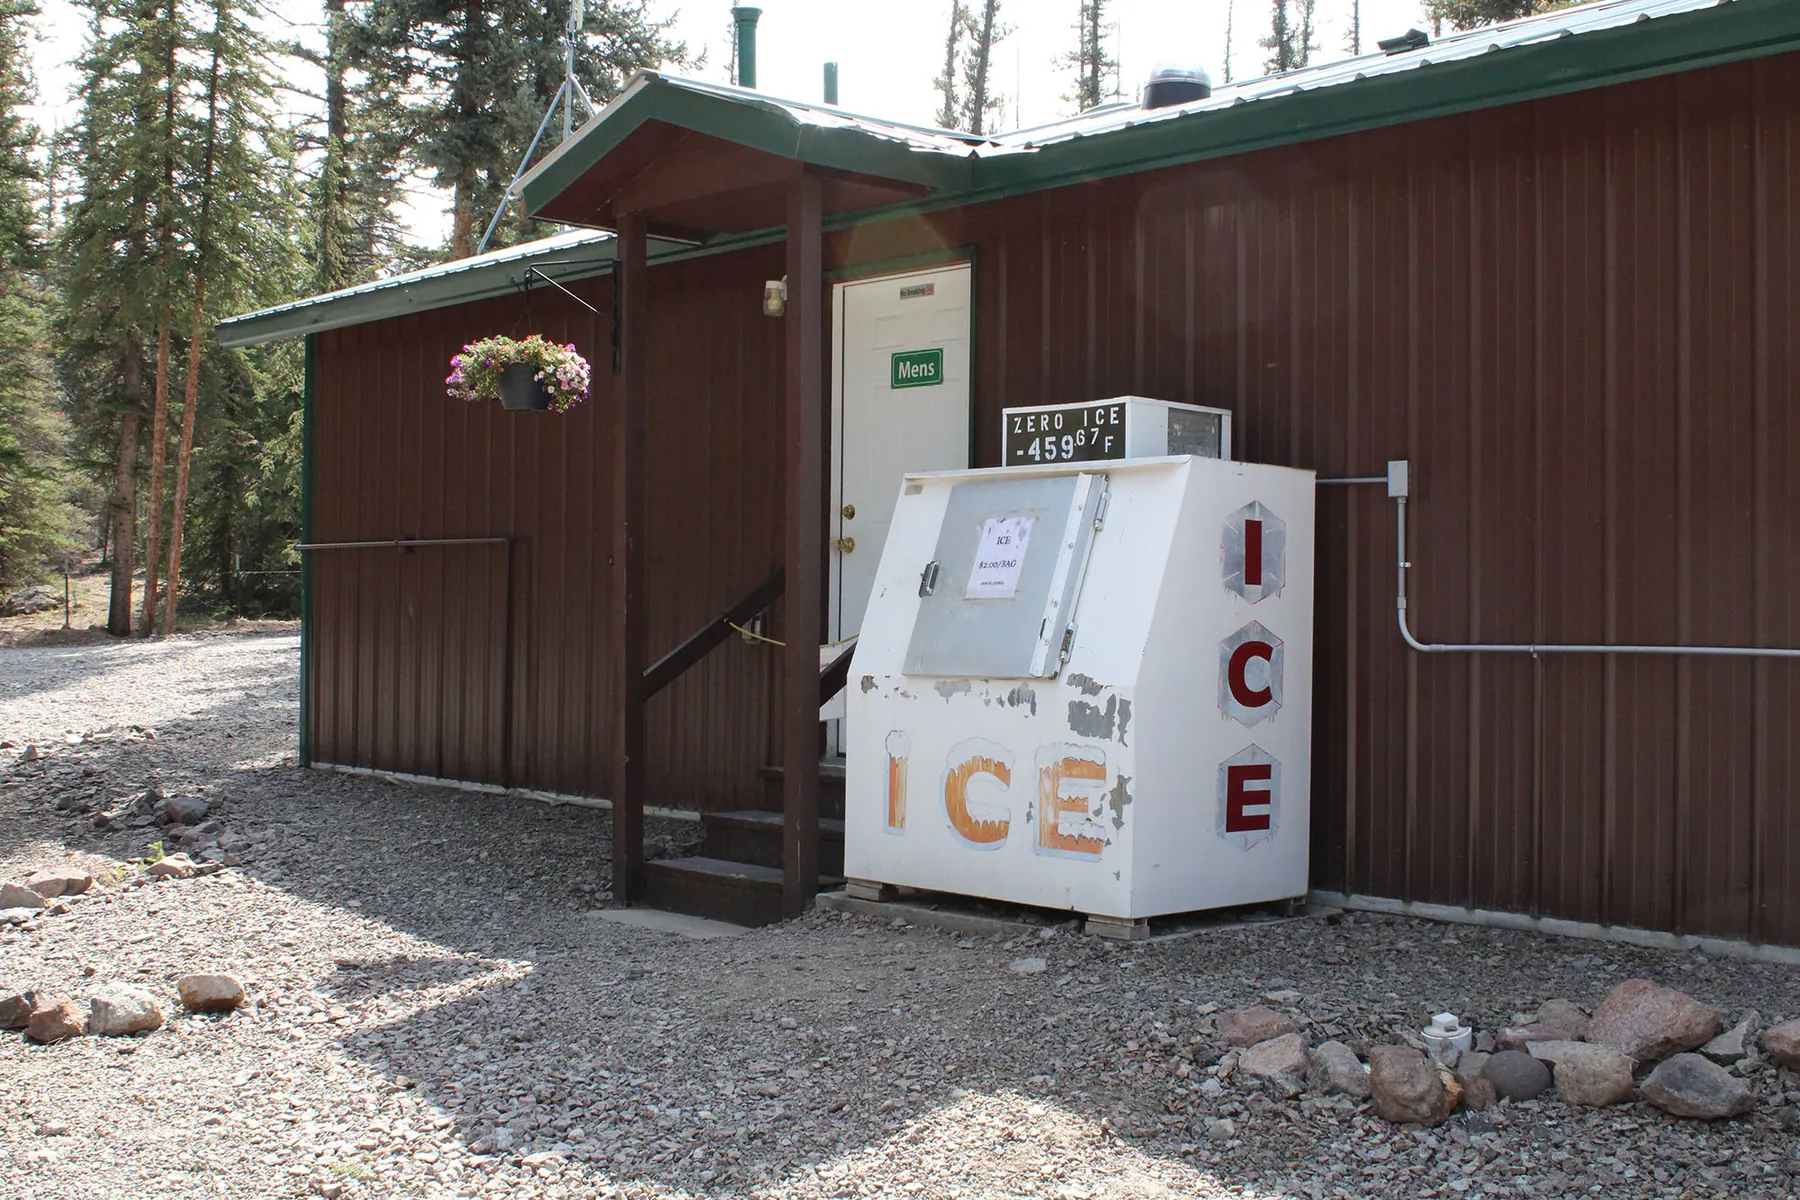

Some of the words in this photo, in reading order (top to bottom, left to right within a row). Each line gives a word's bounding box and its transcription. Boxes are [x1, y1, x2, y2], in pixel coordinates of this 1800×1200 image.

[898, 361, 935, 379] Mens
[1014, 413, 1063, 434] ZERO
[1083, 406, 1120, 427] ICE
[1104, 435, 1114, 453] F
[996, 536, 1012, 545] ICE
[1226, 519, 1274, 834] ICE
[885, 731, 1107, 861] ICE
